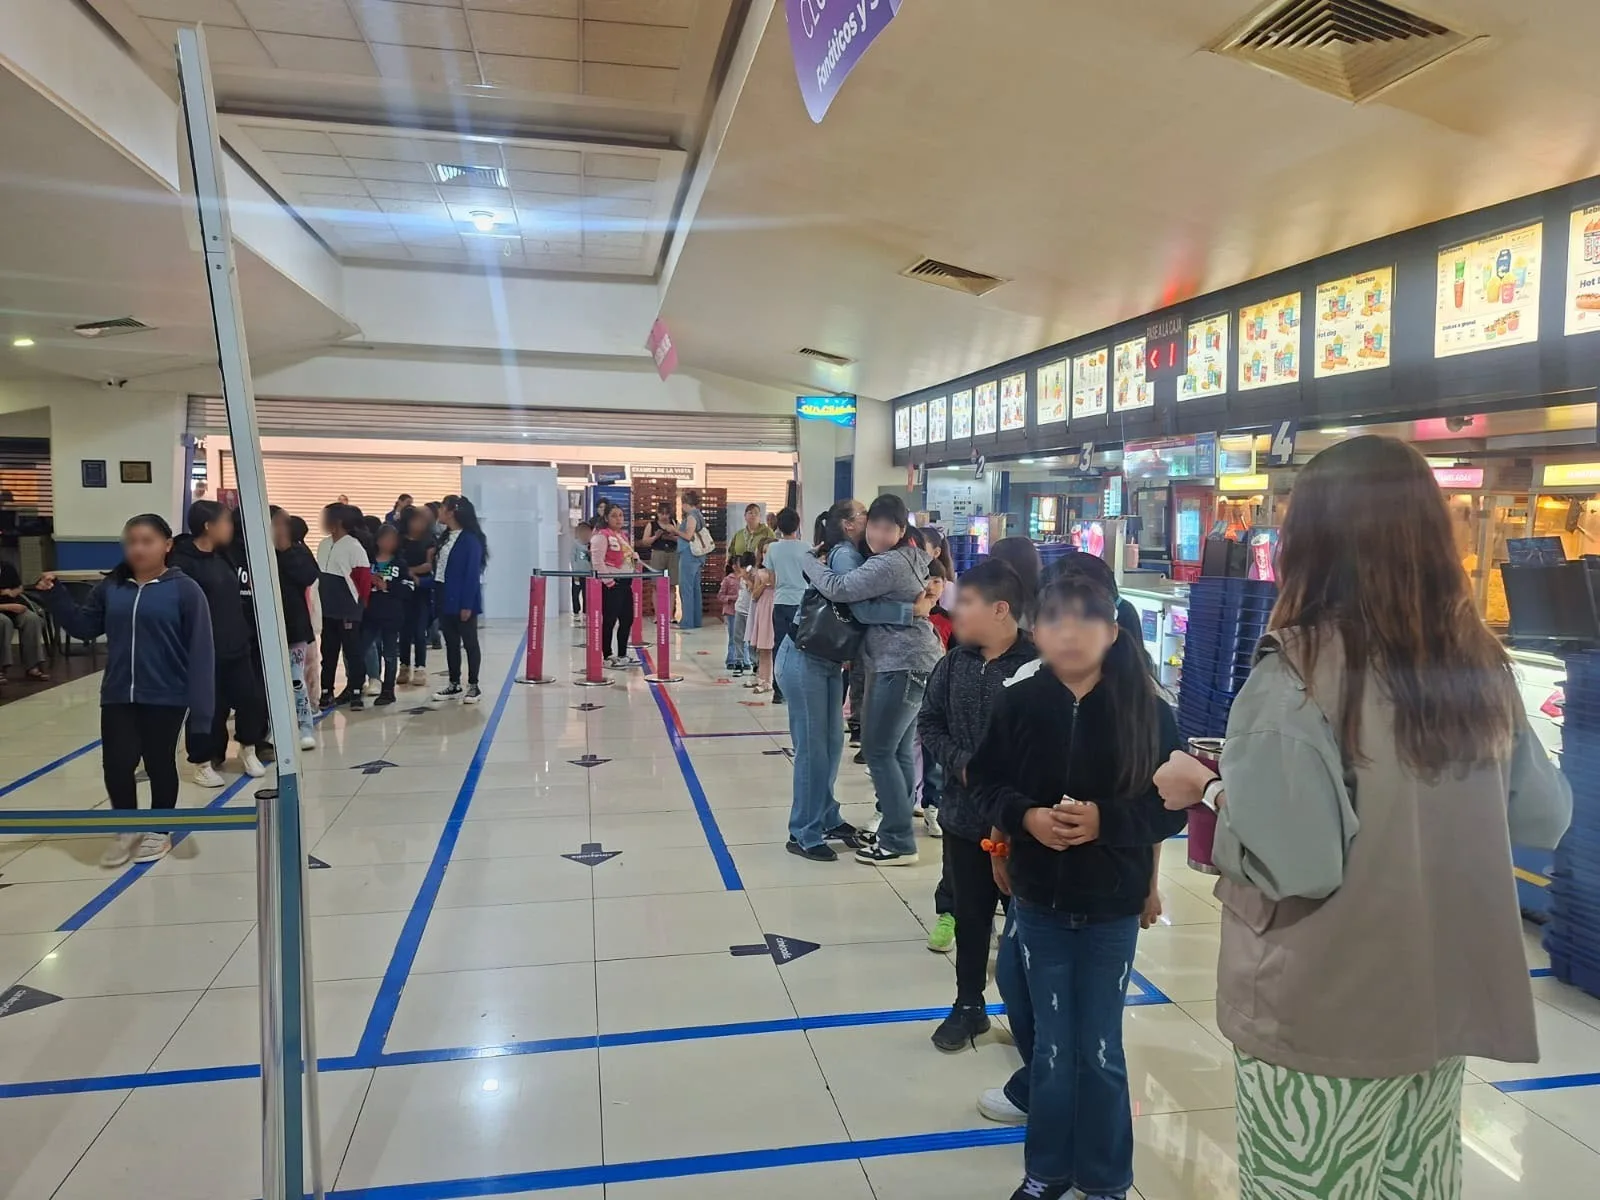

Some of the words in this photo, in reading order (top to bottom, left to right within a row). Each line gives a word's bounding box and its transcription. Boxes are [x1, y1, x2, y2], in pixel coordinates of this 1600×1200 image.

[816, 12, 858, 93] Fanáticos
[857, 0, 867, 32] y
[1079, 441, 1093, 472] 3
[1271, 421, 1293, 464] 4
[975, 455, 986, 479] 2
